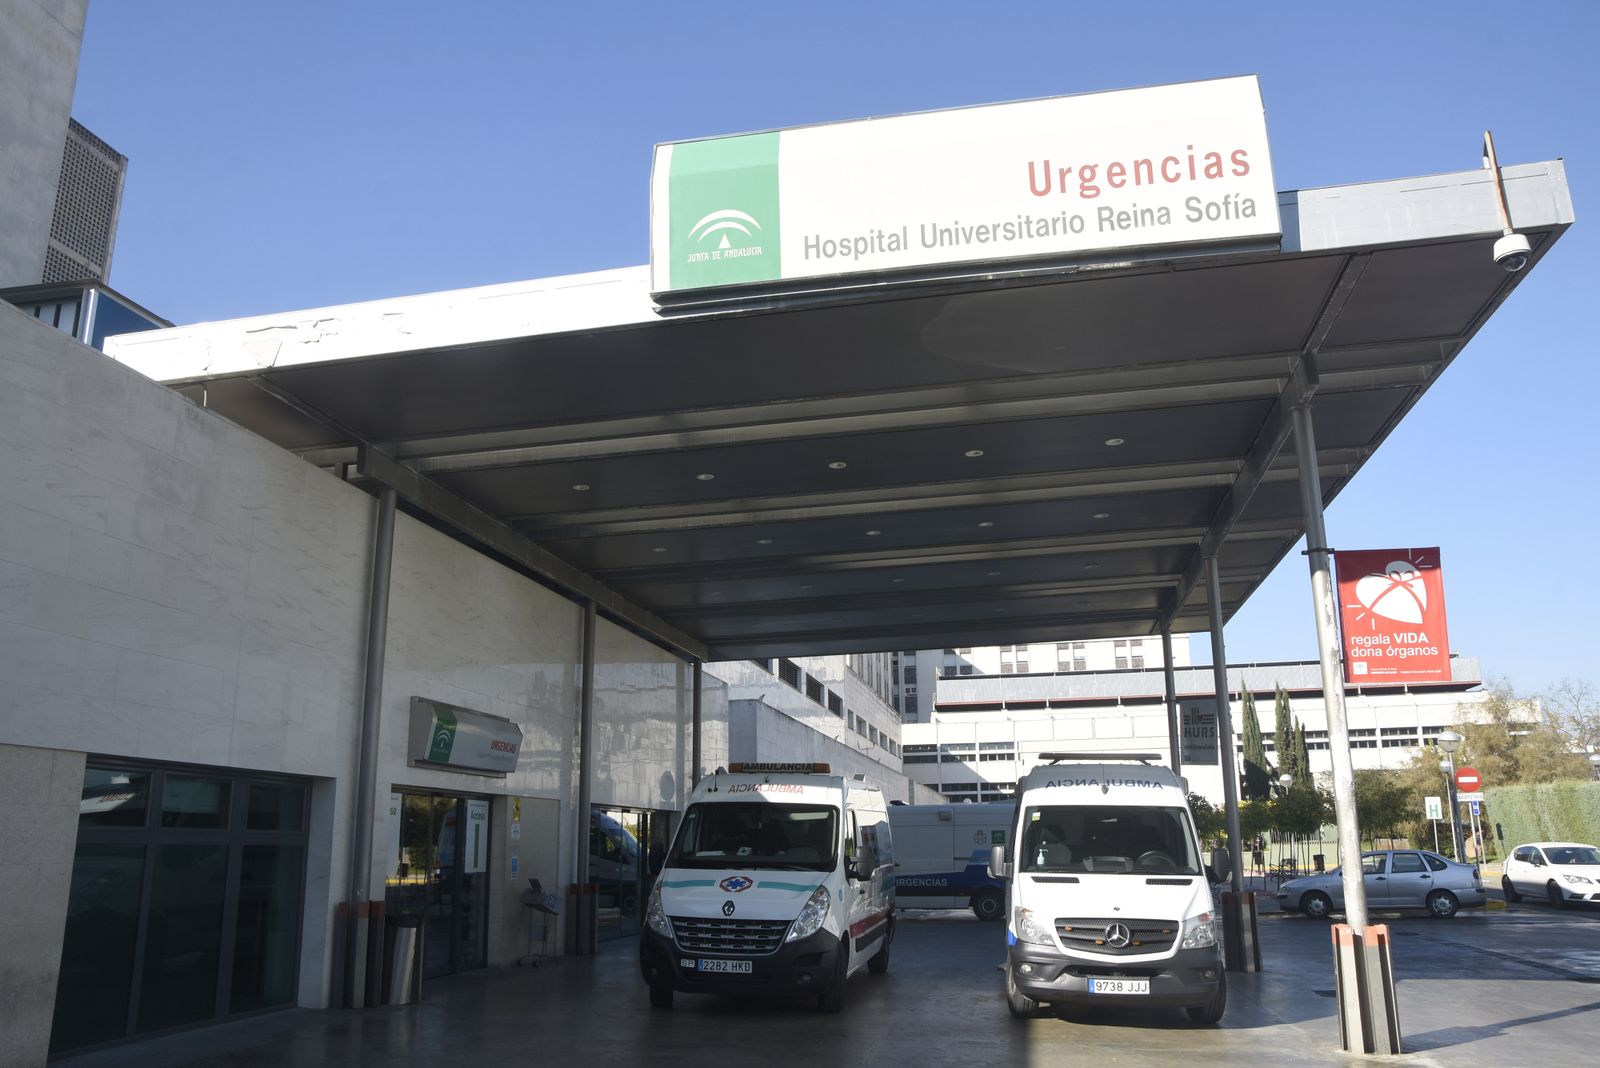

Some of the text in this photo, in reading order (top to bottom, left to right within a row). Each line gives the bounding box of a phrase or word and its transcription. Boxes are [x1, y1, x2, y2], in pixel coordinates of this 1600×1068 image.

[1028, 144, 1250, 200] Urgencias
[804, 193, 1257, 261] Hospital Universitario Reina Sofía
[688, 252, 709, 262] JUNTA
[712, 250, 721, 260] DE
[1351, 632, 1429, 647] regala VIDA
[1351, 645, 1439, 659] dona órganos
[1184, 726, 1215, 738] HURS
[743, 763, 813, 771] AMBULANCIA
[1429, 804, 1439, 818] H
[703, 960, 751, 972] 2282 HKD
[1096, 981, 1147, 992] 9738 JJJ
